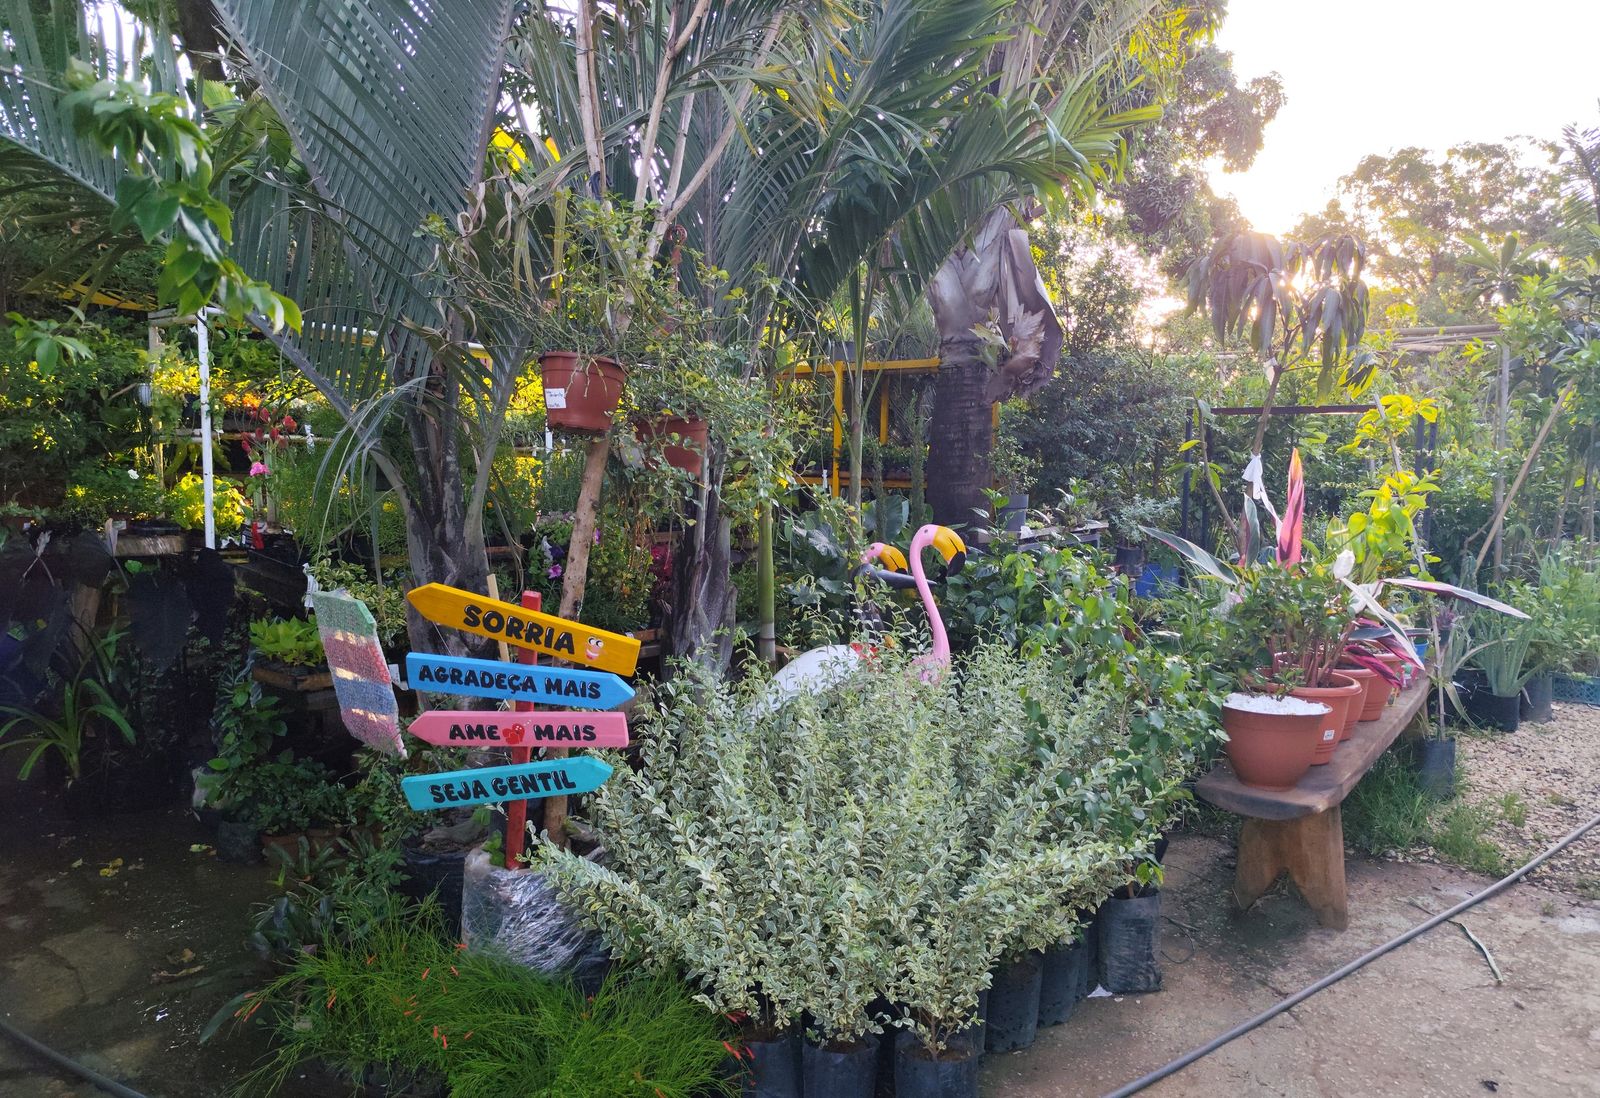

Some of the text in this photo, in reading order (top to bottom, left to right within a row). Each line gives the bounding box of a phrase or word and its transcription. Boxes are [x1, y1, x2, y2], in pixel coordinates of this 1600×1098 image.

[463, 604, 575, 655] SORRIA
[418, 664, 601, 699] AGRADEÇA MAIS
[449, 724, 597, 742] AME MAIS
[428, 770, 577, 804] SEJA GENTIL
